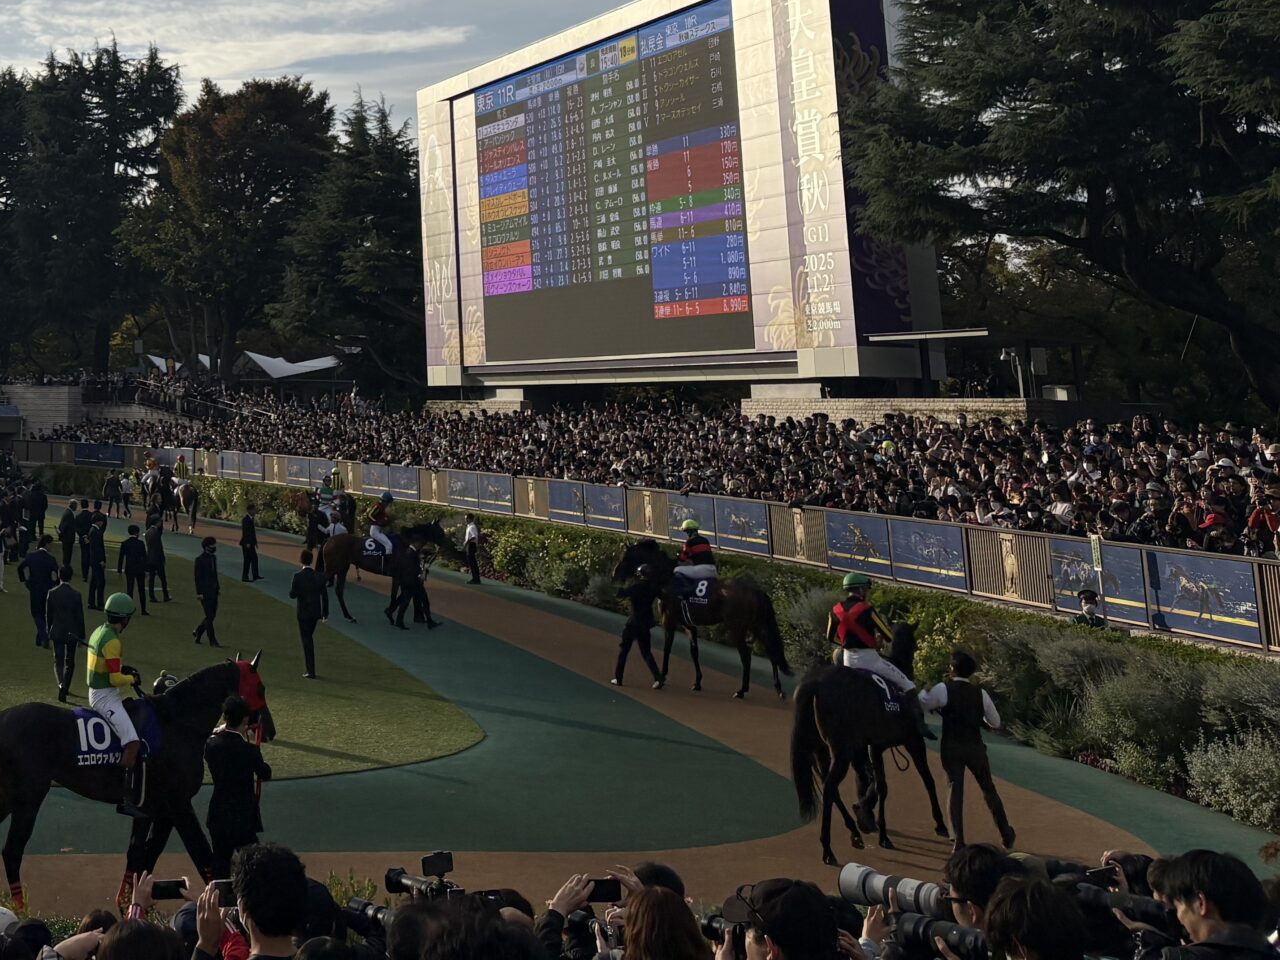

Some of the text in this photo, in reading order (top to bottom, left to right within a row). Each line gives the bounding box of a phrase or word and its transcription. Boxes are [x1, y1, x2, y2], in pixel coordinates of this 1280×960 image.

[640, 33, 664, 54] 払戻金
[476, 90, 494, 112] 東京
[497, 84, 514, 104] 11R
[651, 245, 671, 256] ワイド
[803, 252, 834, 273] 2025
[805, 301, 841, 314] 東京競馬場
[365, 538, 376, 550] 6
[696, 580, 708, 597] 8
[871, 673, 891, 700] 9
[77, 717, 112, 751] 10
[77, 751, 122, 766] エコロヴァルツ
